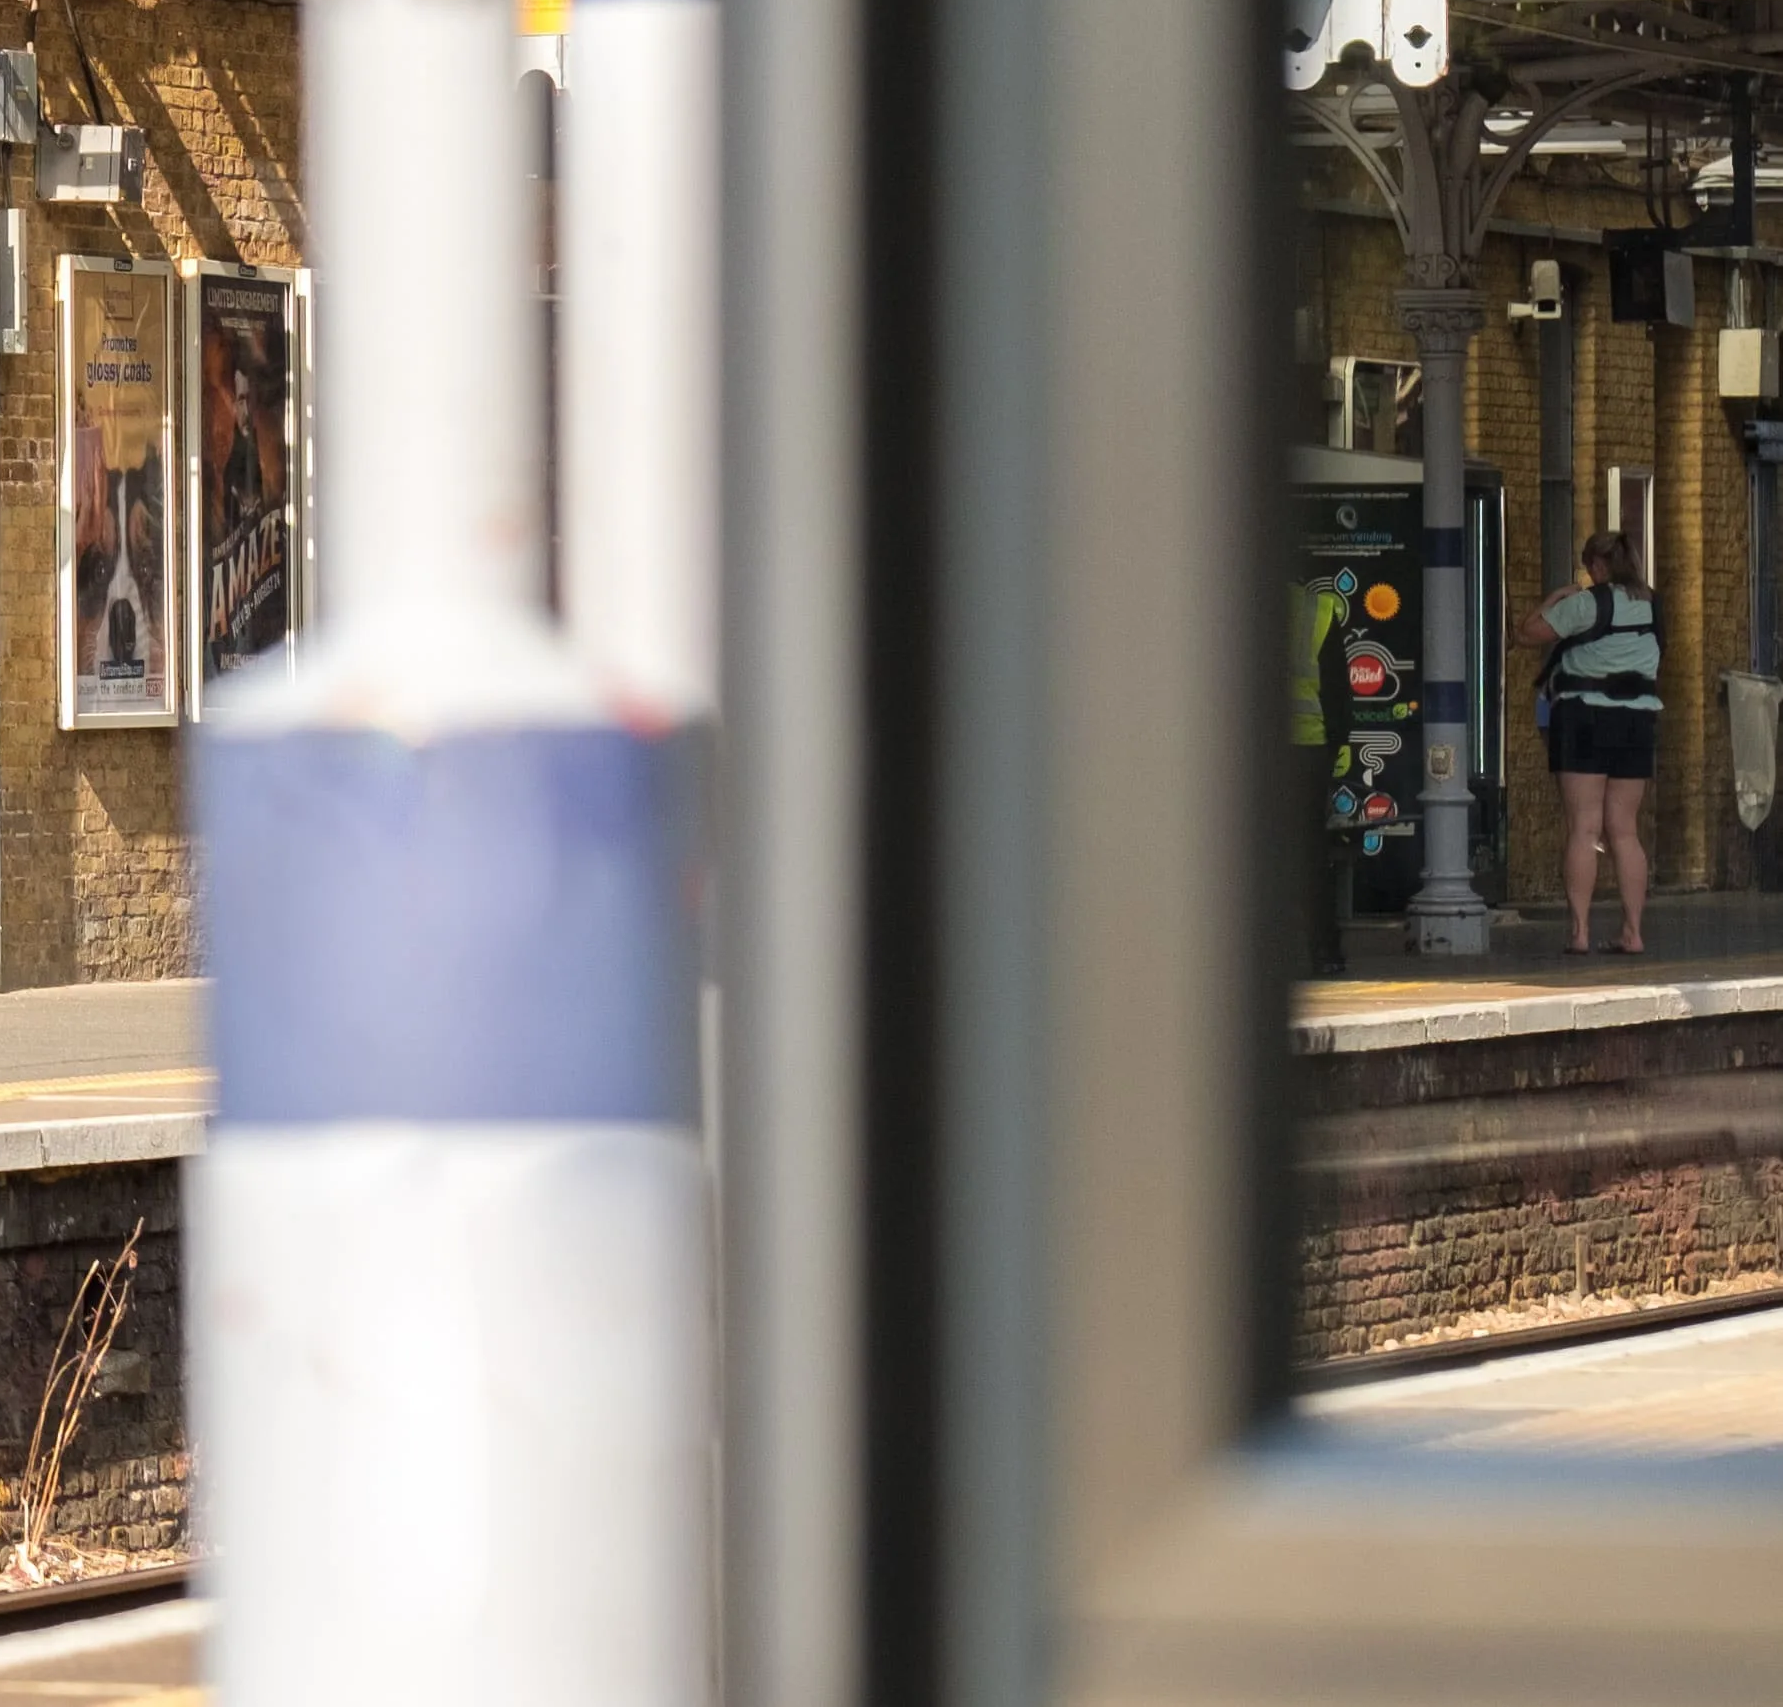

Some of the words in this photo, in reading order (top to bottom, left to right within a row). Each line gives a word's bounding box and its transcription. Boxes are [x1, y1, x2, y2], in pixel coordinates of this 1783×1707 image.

[207, 287, 235, 310] LIMITED
[235, 289, 279, 313] ENGAGEMENT
[101, 331, 137, 352] Promotes
[86, 353, 121, 388] glossy
[123, 359, 152, 383] coats
[207, 508, 282, 643] AMAZE
